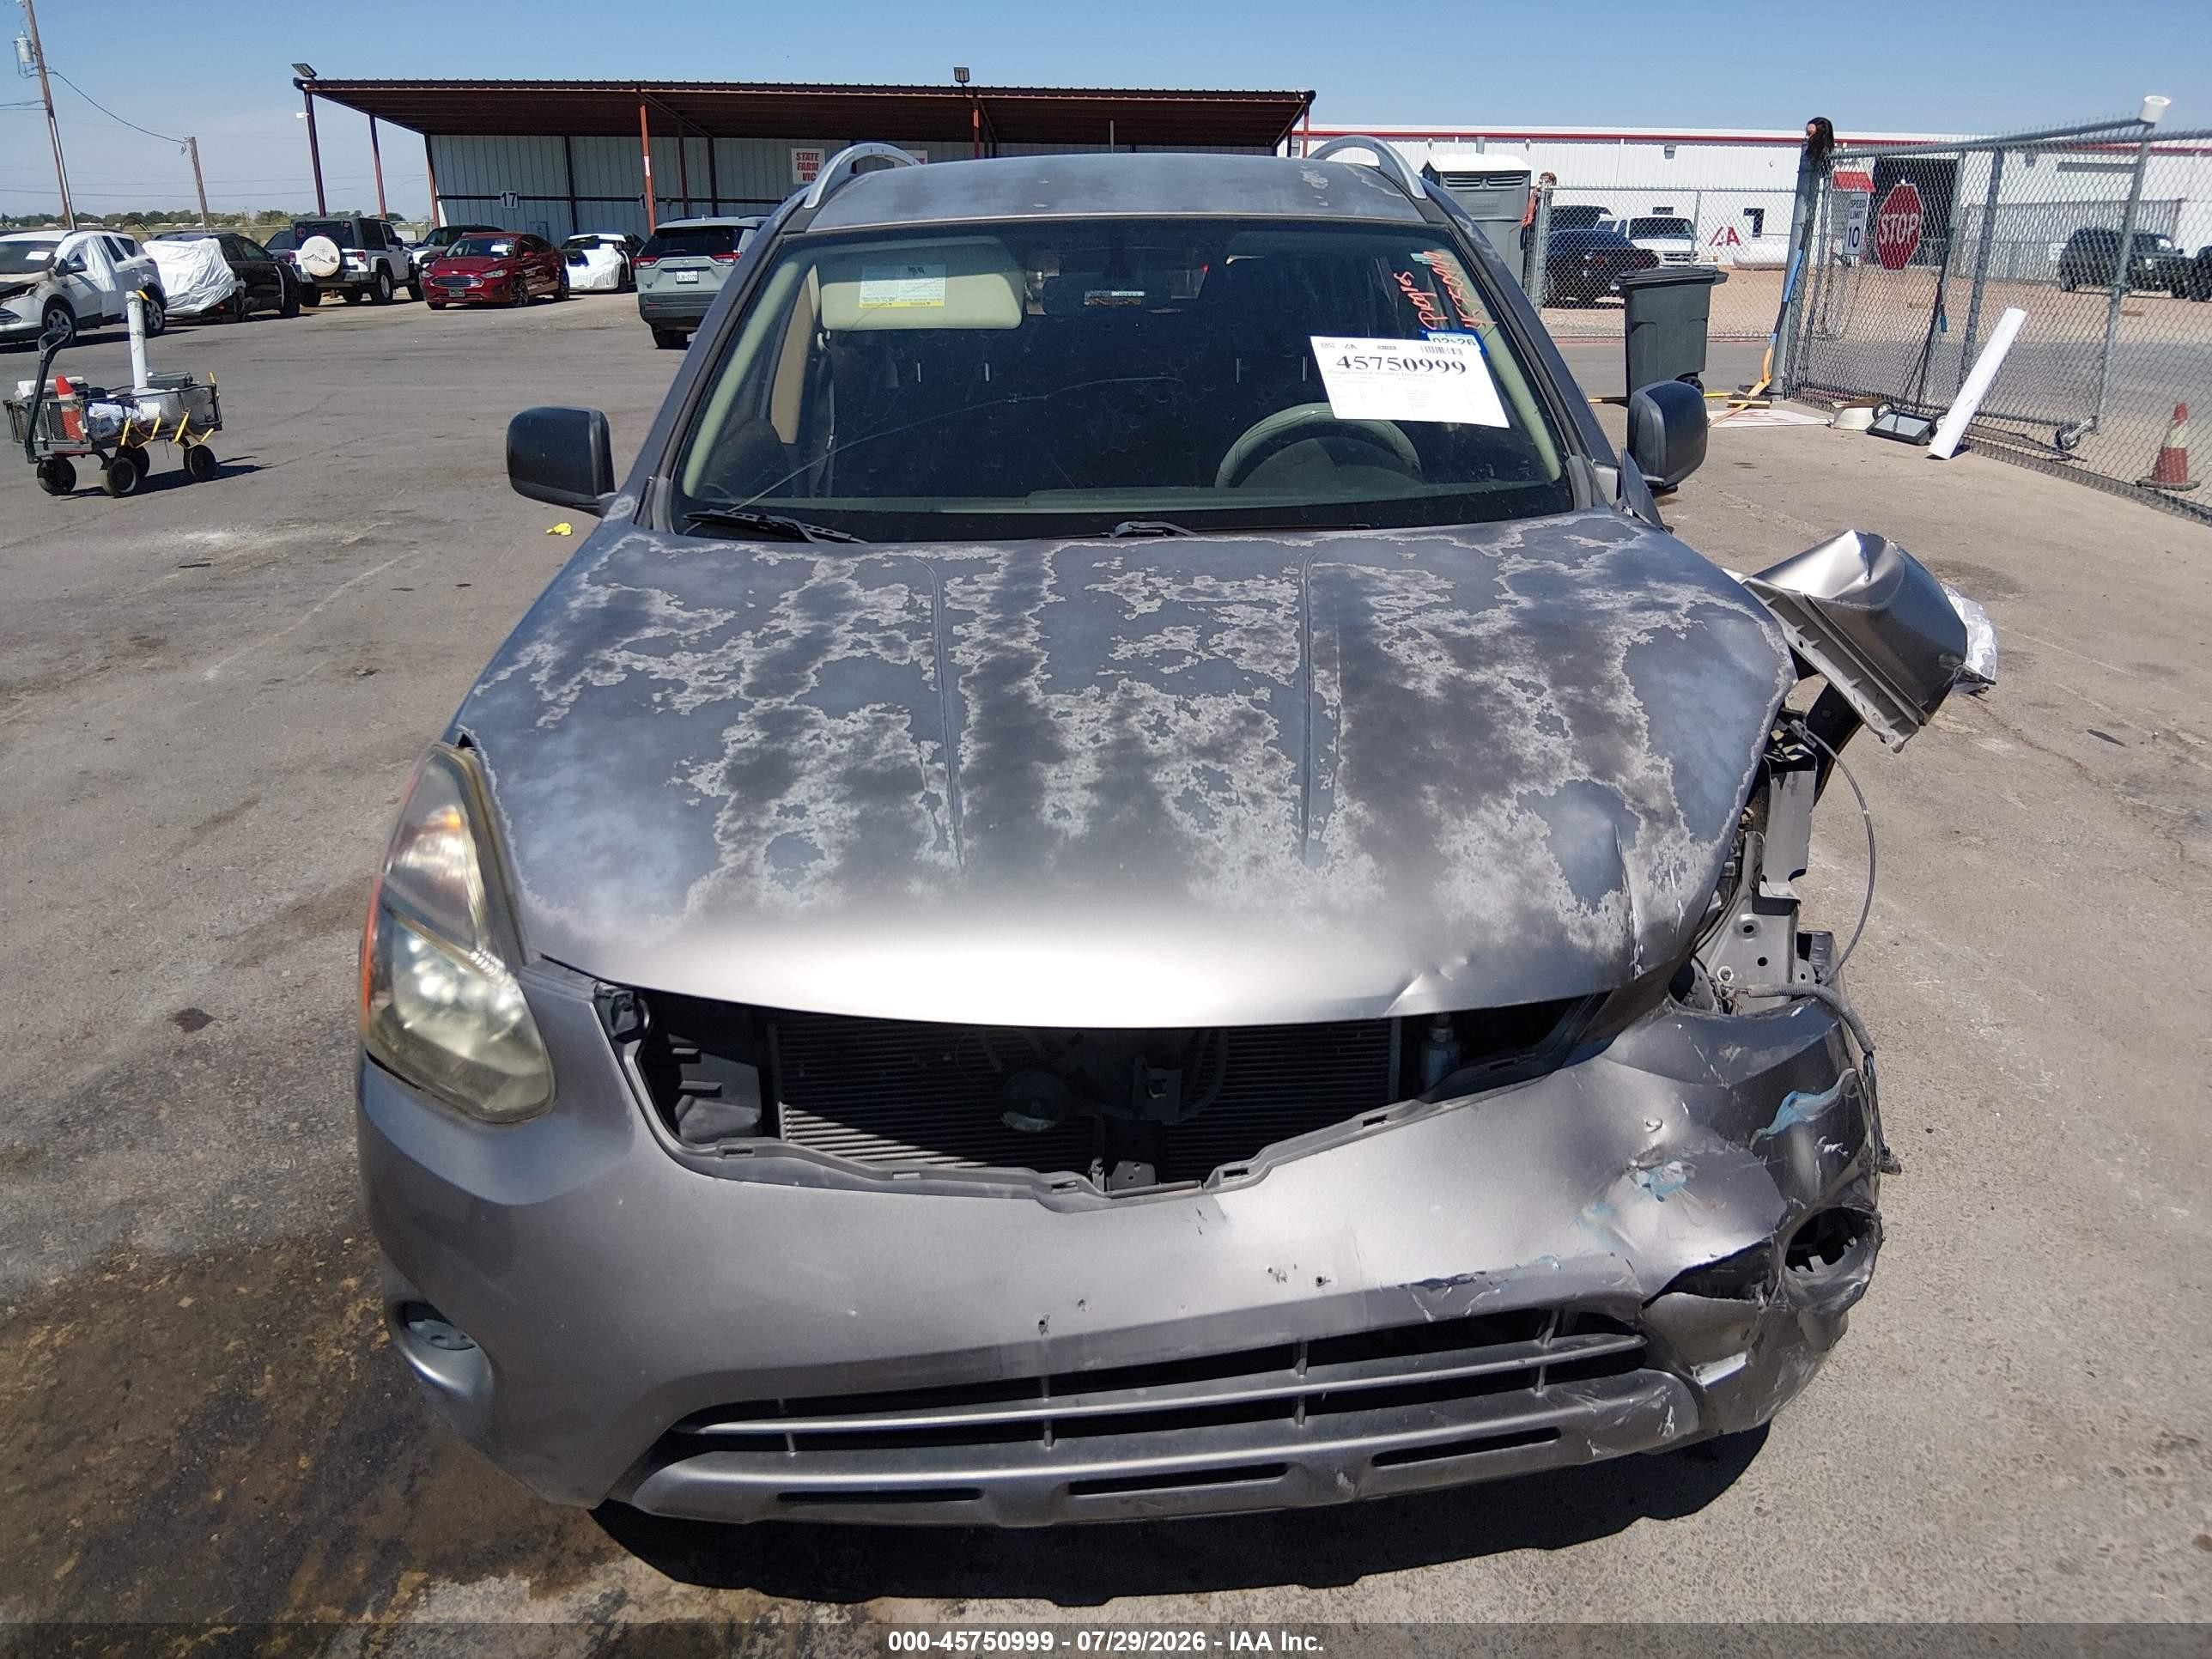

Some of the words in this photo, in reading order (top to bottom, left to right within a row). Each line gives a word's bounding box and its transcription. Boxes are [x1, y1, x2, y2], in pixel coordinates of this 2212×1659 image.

[796, 152, 819, 161] STATE
[797, 162, 819, 172] FARM
[501, 192, 517, 207] 17
[1850, 199, 1866, 209] SPEED
[1850, 210, 1863, 220] LIMIT
[1878, 212, 1920, 245] STOP
[1848, 226, 1861, 248] 10
[1336, 355, 1467, 375] 45750999
